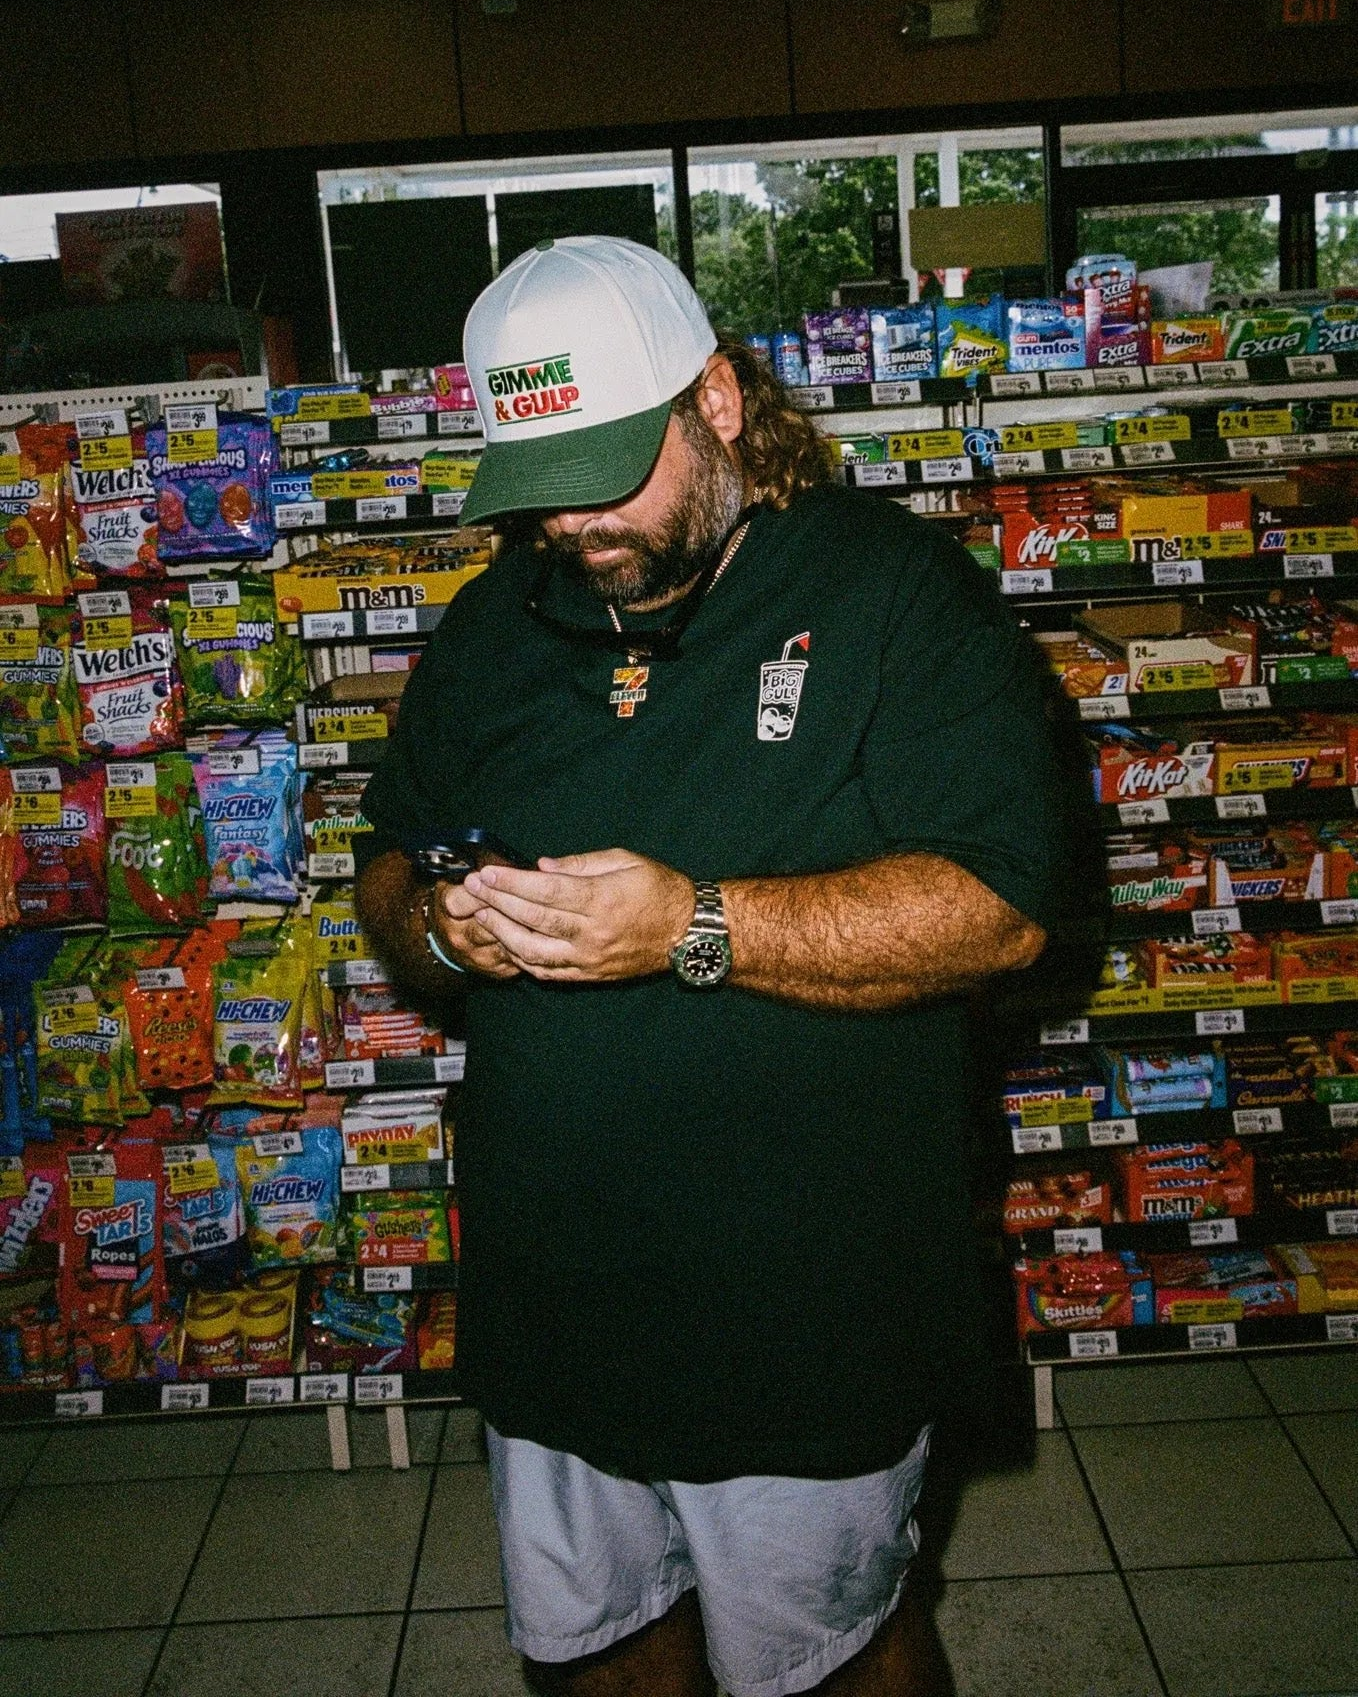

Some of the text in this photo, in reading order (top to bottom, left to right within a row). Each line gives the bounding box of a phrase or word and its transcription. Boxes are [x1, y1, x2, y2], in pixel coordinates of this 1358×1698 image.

[1160, 331, 1207, 346] Trident
[1239, 332, 1300, 358] Extra
[952, 346, 997, 360] Trident
[1015, 342, 1080, 355] mentos
[1098, 342, 1138, 363] Extra
[827, 352, 868, 366] BREAKERS
[891, 349, 933, 363] BREAKERS
[957, 359, 980, 367] VIBES
[819, 366, 863, 377] ICE CUBES
[899, 362, 929, 373] CUBES
[488, 358, 574, 397] GIMME
[494, 386, 580, 422] & GULP
[1336, 407, 1344, 420] 2
[1120, 424, 1129, 437] 2
[1134, 421, 1148, 435] $4
[1222, 417, 1231, 430] 2
[1235, 416, 1249, 429] $4
[171, 434, 195, 447] 2 $5
[1006, 432, 1015, 444] 2
[1019, 430, 1034, 443] $4
[83, 442, 108, 455] 2 $5
[893, 440, 901, 452] 2
[905, 438, 920, 450] $4
[98, 513, 131, 530] Fruit
[1094, 512, 1117, 523] KING
[1258, 512, 1272, 524] 24
[88, 523, 139, 541] Snacks
[1096, 521, 1117, 530] SIZE
[1220, 520, 1245, 531] SHARE
[1185, 538, 1193, 551] 2
[1197, 536, 1213, 550] $5
[1290, 533, 1298, 547] 2
[1303, 532, 1317, 546] $5
[1078, 550, 1091, 562] $2
[339, 584, 426, 609] m&m's
[189, 611, 214, 623] 2 $5
[86, 621, 109, 635] 2 $5
[213, 638, 259, 650] GUMMIES
[77, 638, 166, 677] Welch's
[1135, 646, 1148, 658] 24
[4, 669, 58, 684] GUMMIES
[1108, 674, 1119, 689] 2
[1147, 671, 1155, 684] 2
[1158, 670, 1174, 683] $5
[107, 689, 145, 709] Fruit
[763, 687, 798, 700] GULP
[97, 701, 152, 722] Snacks
[318, 722, 327, 735] 2
[330, 719, 345, 733] $4
[1119, 759, 1188, 796] KitKat
[109, 789, 132, 801] 2 $5
[14, 797, 22, 809] 2
[204, 798, 275, 820] HI-CHEW
[213, 824, 268, 841] fantasy
[320, 831, 347, 846] 2 $4
[23, 834, 80, 849] GUMMIES
[1151, 876, 1186, 900] Way
[1232, 878, 1285, 897] NICKERS
[330, 939, 357, 953] 2 $4
[52, 1008, 60, 1020] 2
[216, 1000, 291, 1023] HI-CHEW
[144, 1017, 198, 1037] Reese's
[50, 1035, 110, 1054] GUMMIES
[361, 1145, 370, 1157] 2
[373, 1144, 387, 1157] $4
[172, 1166, 181, 1178] 2
[71, 1181, 80, 1193] 2
[251, 1179, 324, 1205] HI-CHEW
[1004, 1205, 1061, 1220] GRAND
[91, 1248, 136, 1263] Ropes
[361, 1244, 370, 1258] 2
[373, 1244, 388, 1258] $4
[1043, 1303, 1104, 1321] Skittles
